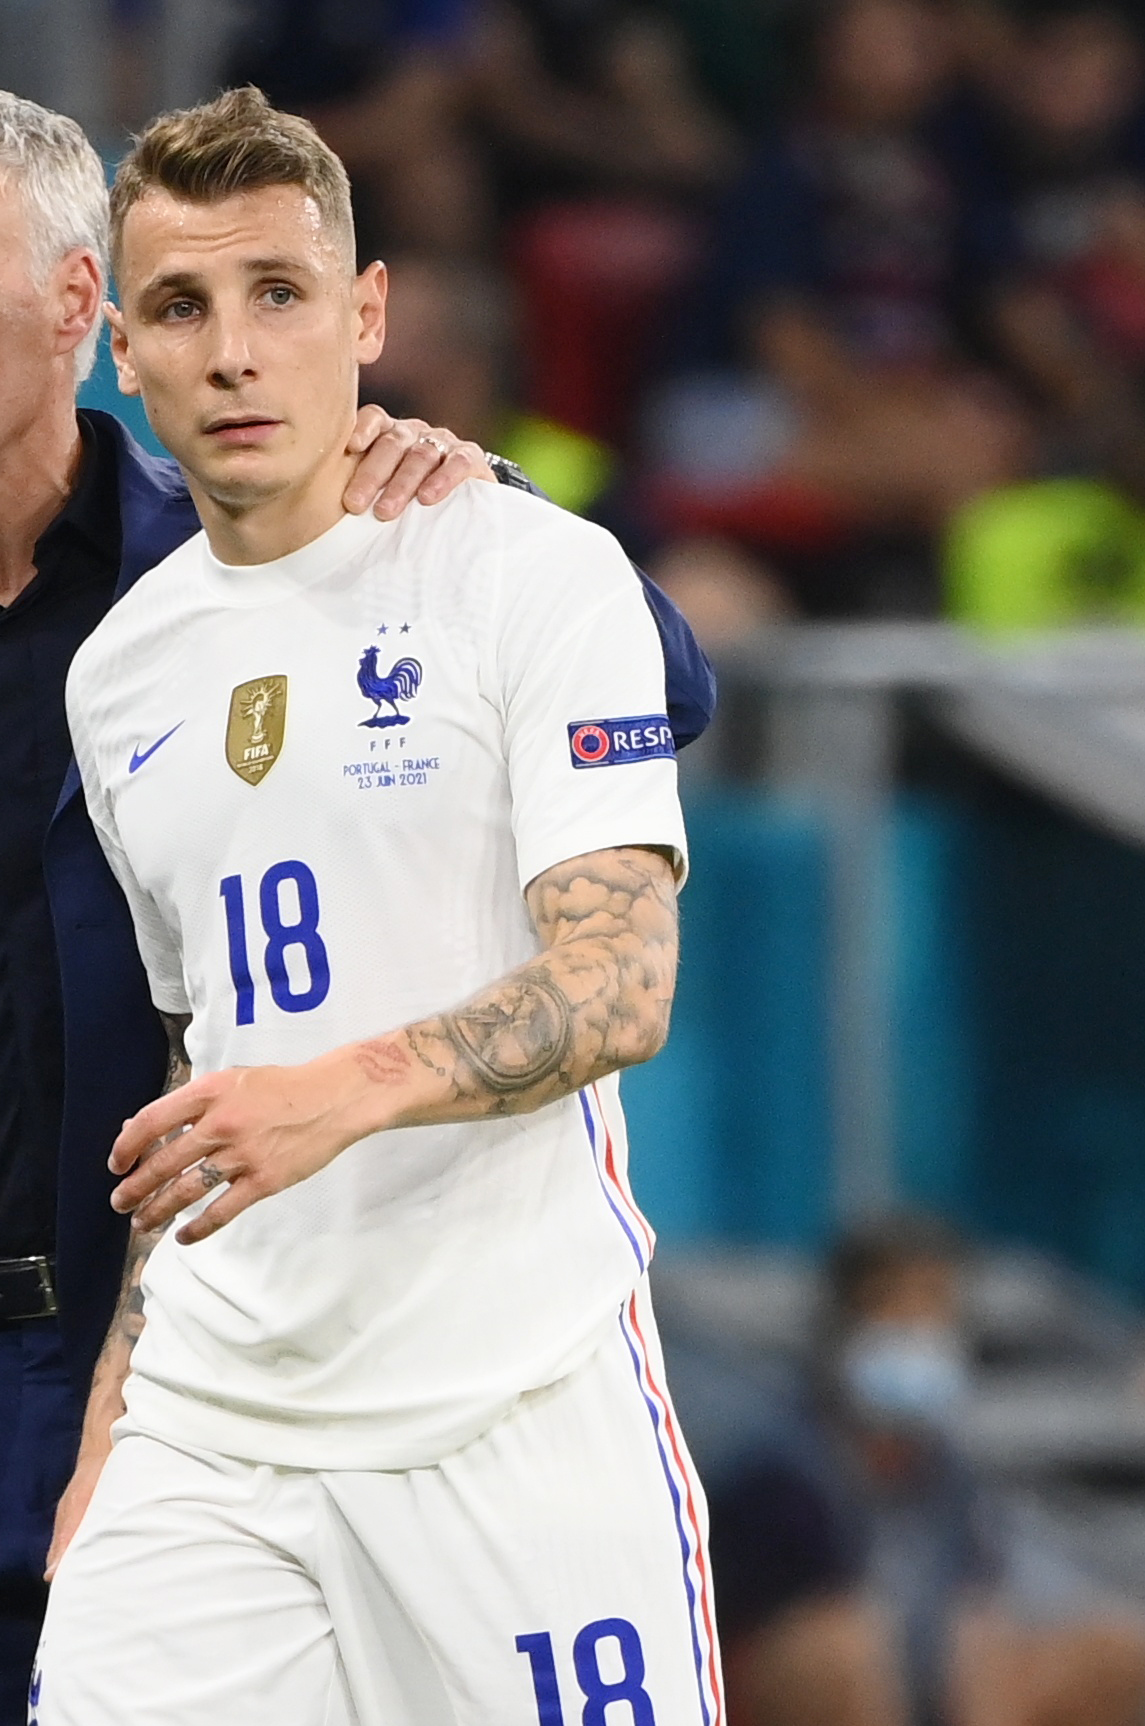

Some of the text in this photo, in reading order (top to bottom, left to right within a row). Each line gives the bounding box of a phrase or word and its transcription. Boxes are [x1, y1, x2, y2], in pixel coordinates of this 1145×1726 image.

[243, 743, 270, 761] FIFA
[343, 760, 391, 777] PORTUGAL
[402, 757, 440, 772] FRANCE
[357, 775, 373, 790] 23
[399, 771, 427, 786] 2021
[219, 859, 331, 1027] 18
[514, 1616, 657, 1726] 18
